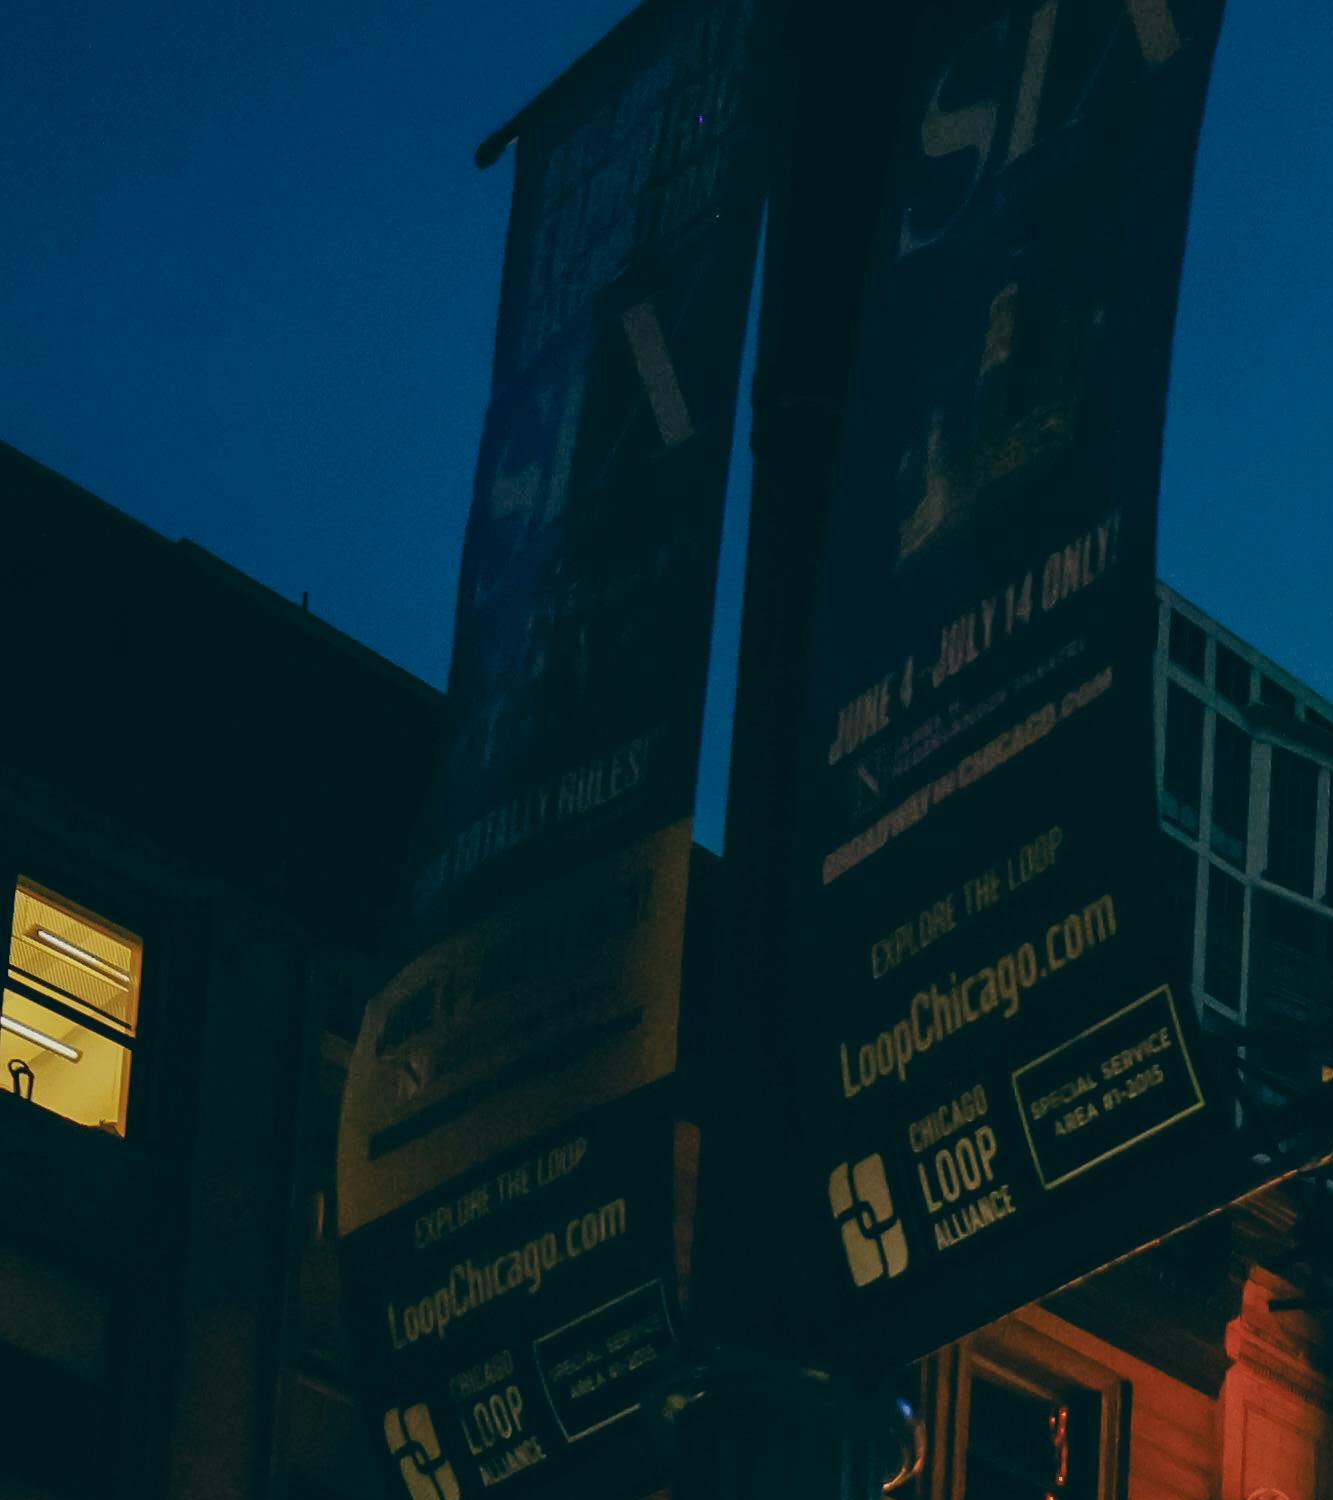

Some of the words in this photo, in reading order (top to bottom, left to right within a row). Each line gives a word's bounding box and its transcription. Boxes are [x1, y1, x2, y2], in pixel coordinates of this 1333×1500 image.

[871, 892, 957, 979] EXPLORE
[963, 865, 1000, 916] THE
[1007, 824, 1063, 891] LOOP
[839, 893, 1118, 1099] LoopChicago.com
[1030, 1073, 1098, 1120] SPECIAL
[1100, 1026, 1172, 1079] SERVICE
[908, 1083, 988, 1153] CHICAGO
[1053, 1101, 1100, 1137] AREA
[414, 1182, 492, 1249] EXPLORE
[496, 1161, 531, 1202] THE
[536, 1136, 588, 1187] LOOP
[917, 1124, 997, 1215] LOOP
[933, 1183, 1016, 1250] ALLIANCE
[387, 1197, 627, 1350] LoopChicago.com
[450, 1350, 514, 1399] CHICAGO
[459, 1385, 524, 1456] LOOP
[478, 1436, 548, 1487] ALLIANCE
